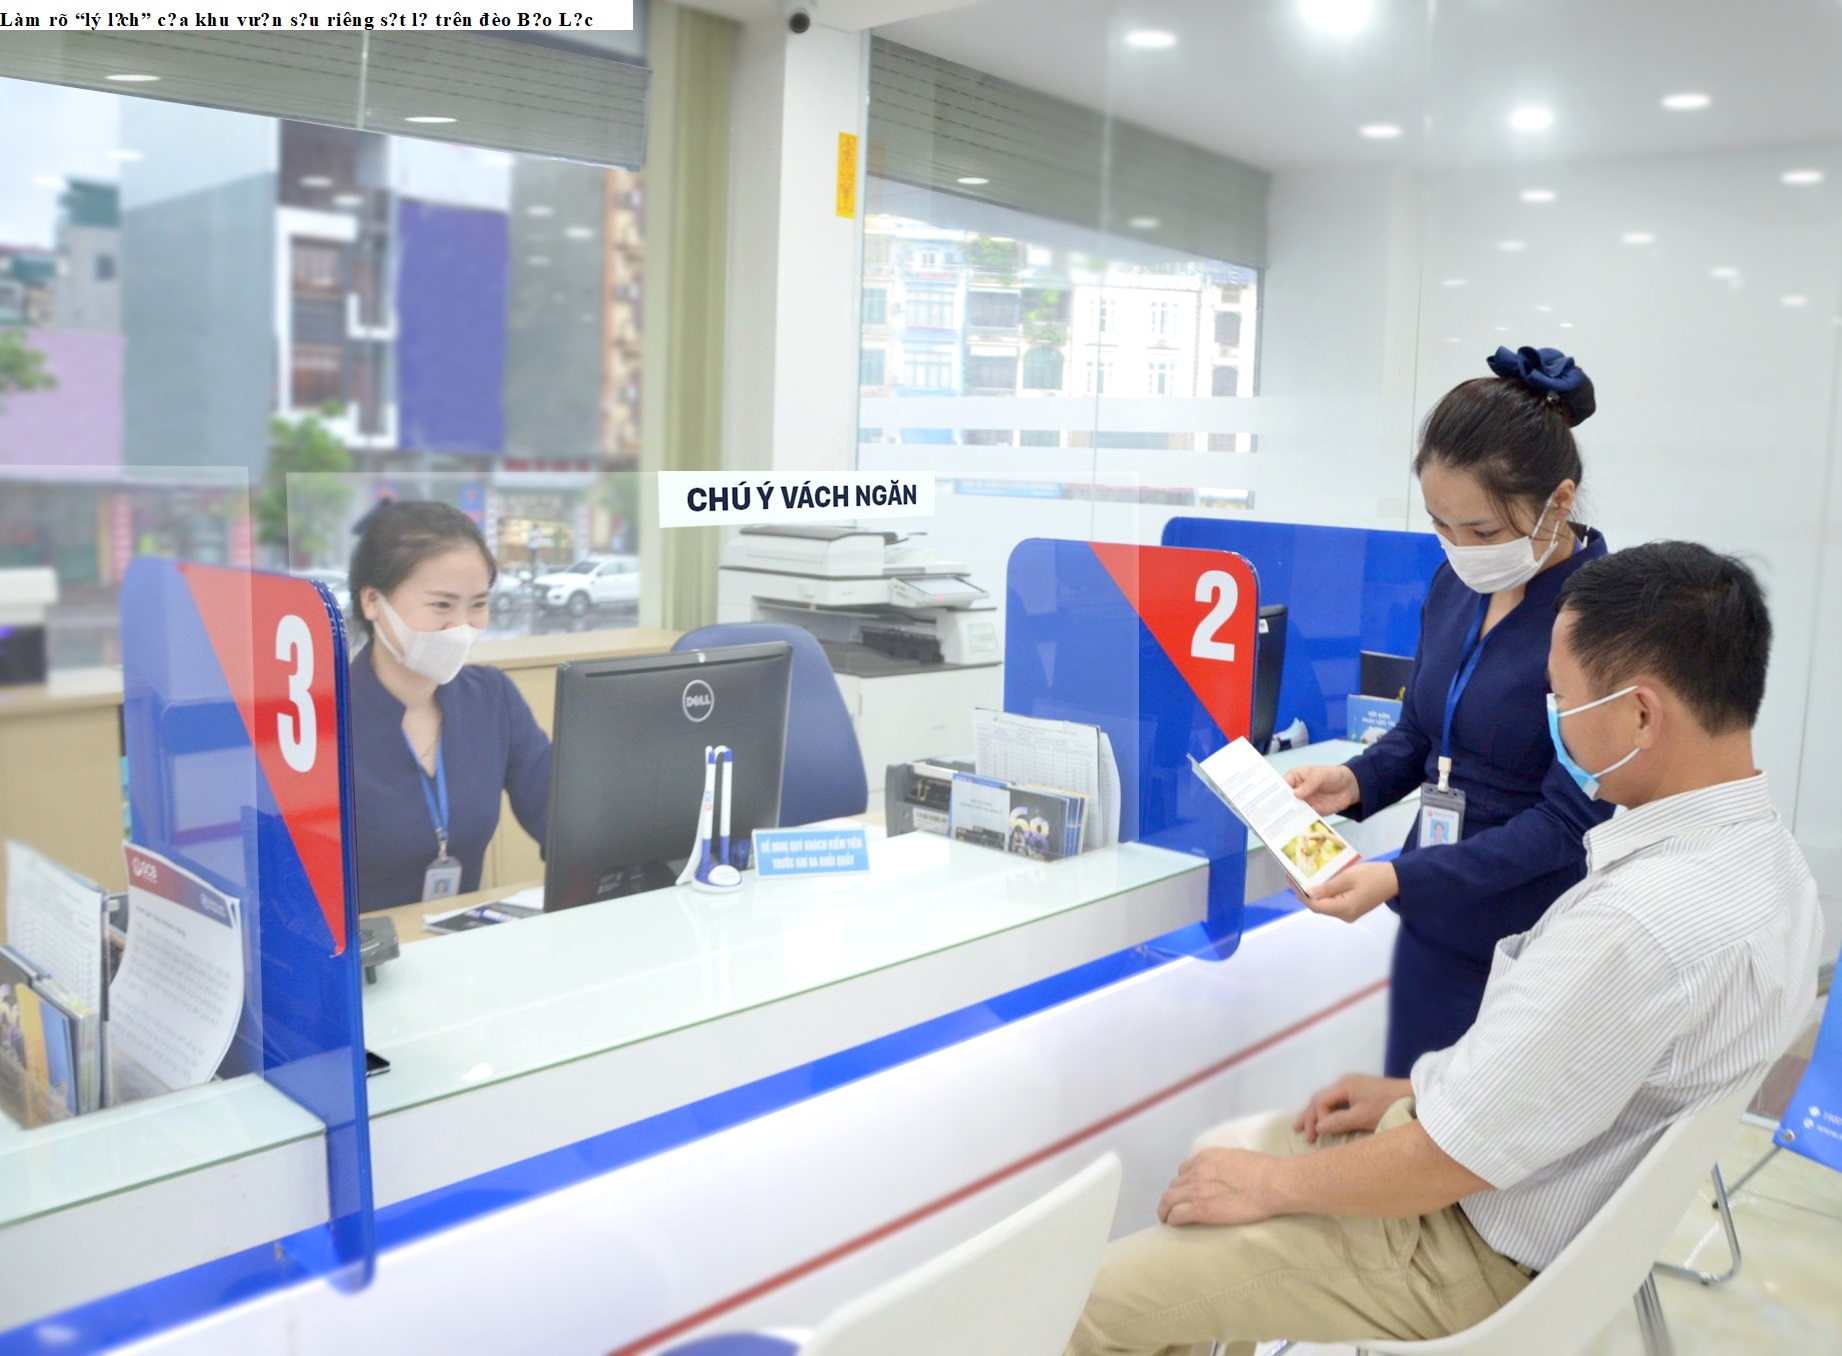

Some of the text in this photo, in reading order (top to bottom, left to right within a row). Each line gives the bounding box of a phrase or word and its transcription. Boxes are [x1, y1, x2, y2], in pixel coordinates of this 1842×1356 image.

[687, 480, 917, 511] CHÚ Ý VÁCH NGĂN
[1191, 570, 1238, 662] 2
[275, 614, 317, 772] 3
[686, 694, 711, 707] DELL
